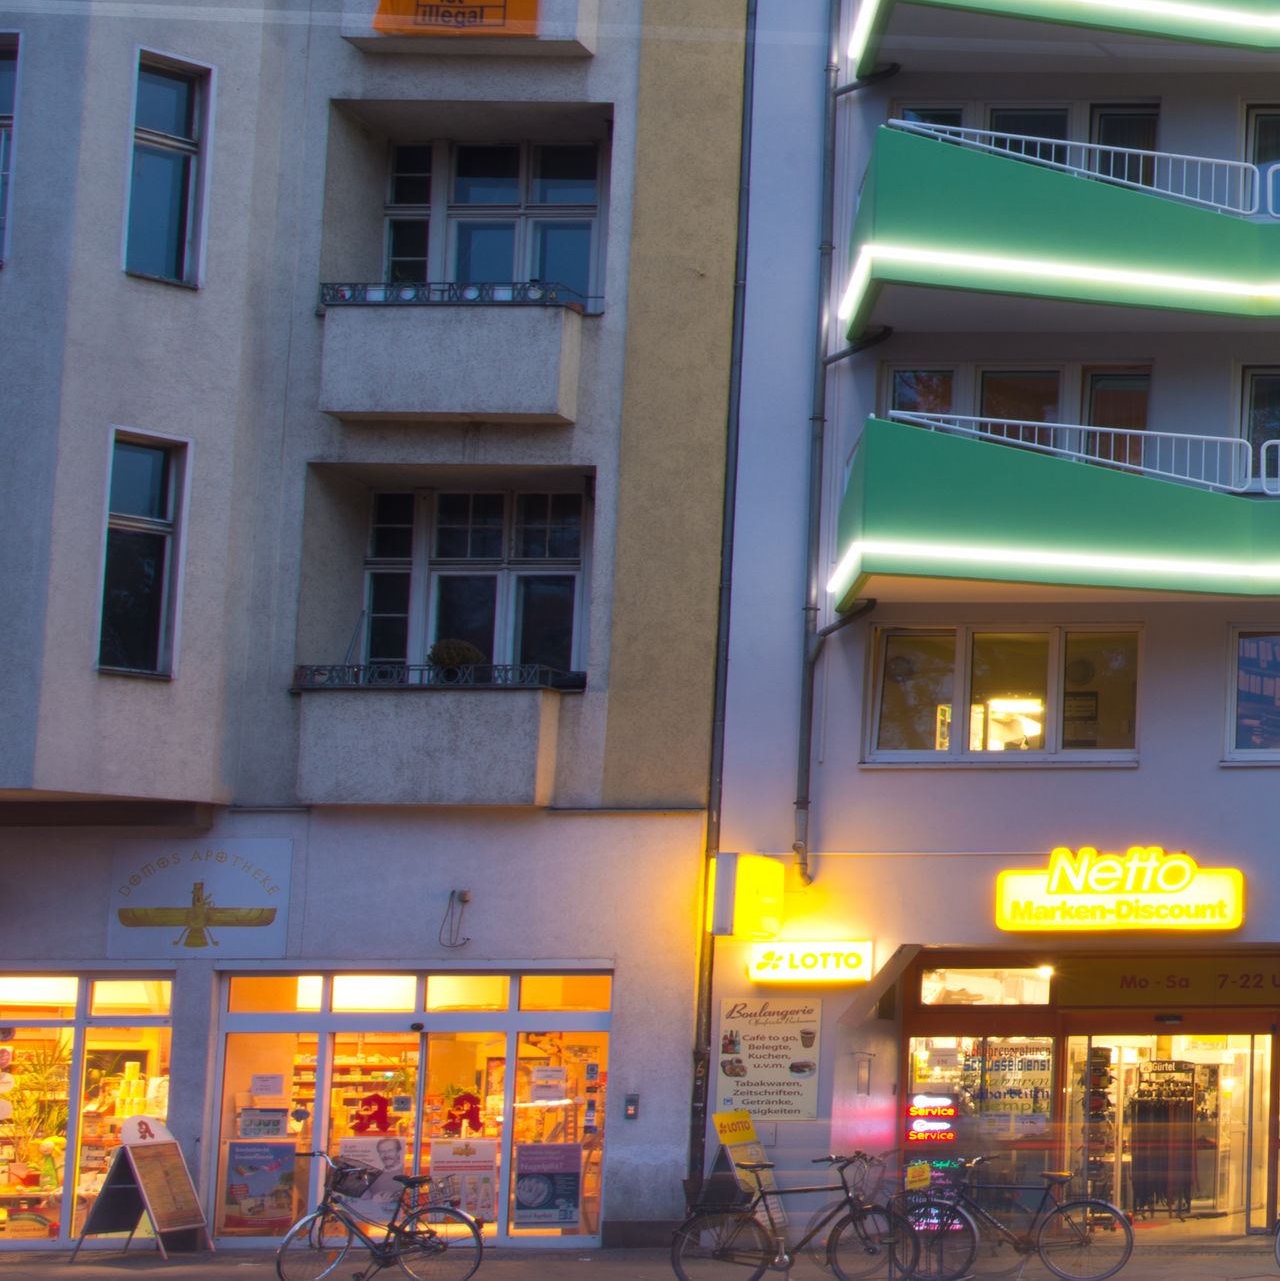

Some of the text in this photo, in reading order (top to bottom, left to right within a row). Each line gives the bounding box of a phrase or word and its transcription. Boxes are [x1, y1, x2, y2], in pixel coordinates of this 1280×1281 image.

[422, 5, 484, 27] illegal
[118, 849, 281, 897] DOMOS APOTHEKE
[1050, 851, 1192, 892] Netto
[1011, 899, 1228, 921] Marken-Discount
[789, 952, 862, 969] LOTTO
[1120, 975, 1149, 989] Mo
[1166, 974, 1190, 989] Sa
[1218, 974, 1264, 989] 7-22
[725, 1002, 814, 1020] Boulangerie
[742, 1033, 767, 1041] Café
[781, 1035, 799, 1043] go,
[748, 1043, 792, 1052] Belegte,
[1152, 1062, 1176, 1072] Gürtel
[735, 1080, 802, 1088] Tabakwaren,
[733, 1089, 803, 1097] Zeitschriften,
[741, 1098, 794, 1106] Getränke,
[909, 1107, 955, 1116] Service
[727, 1120, 751, 1134] LOTTO
[909, 1131, 954, 1140] Service
